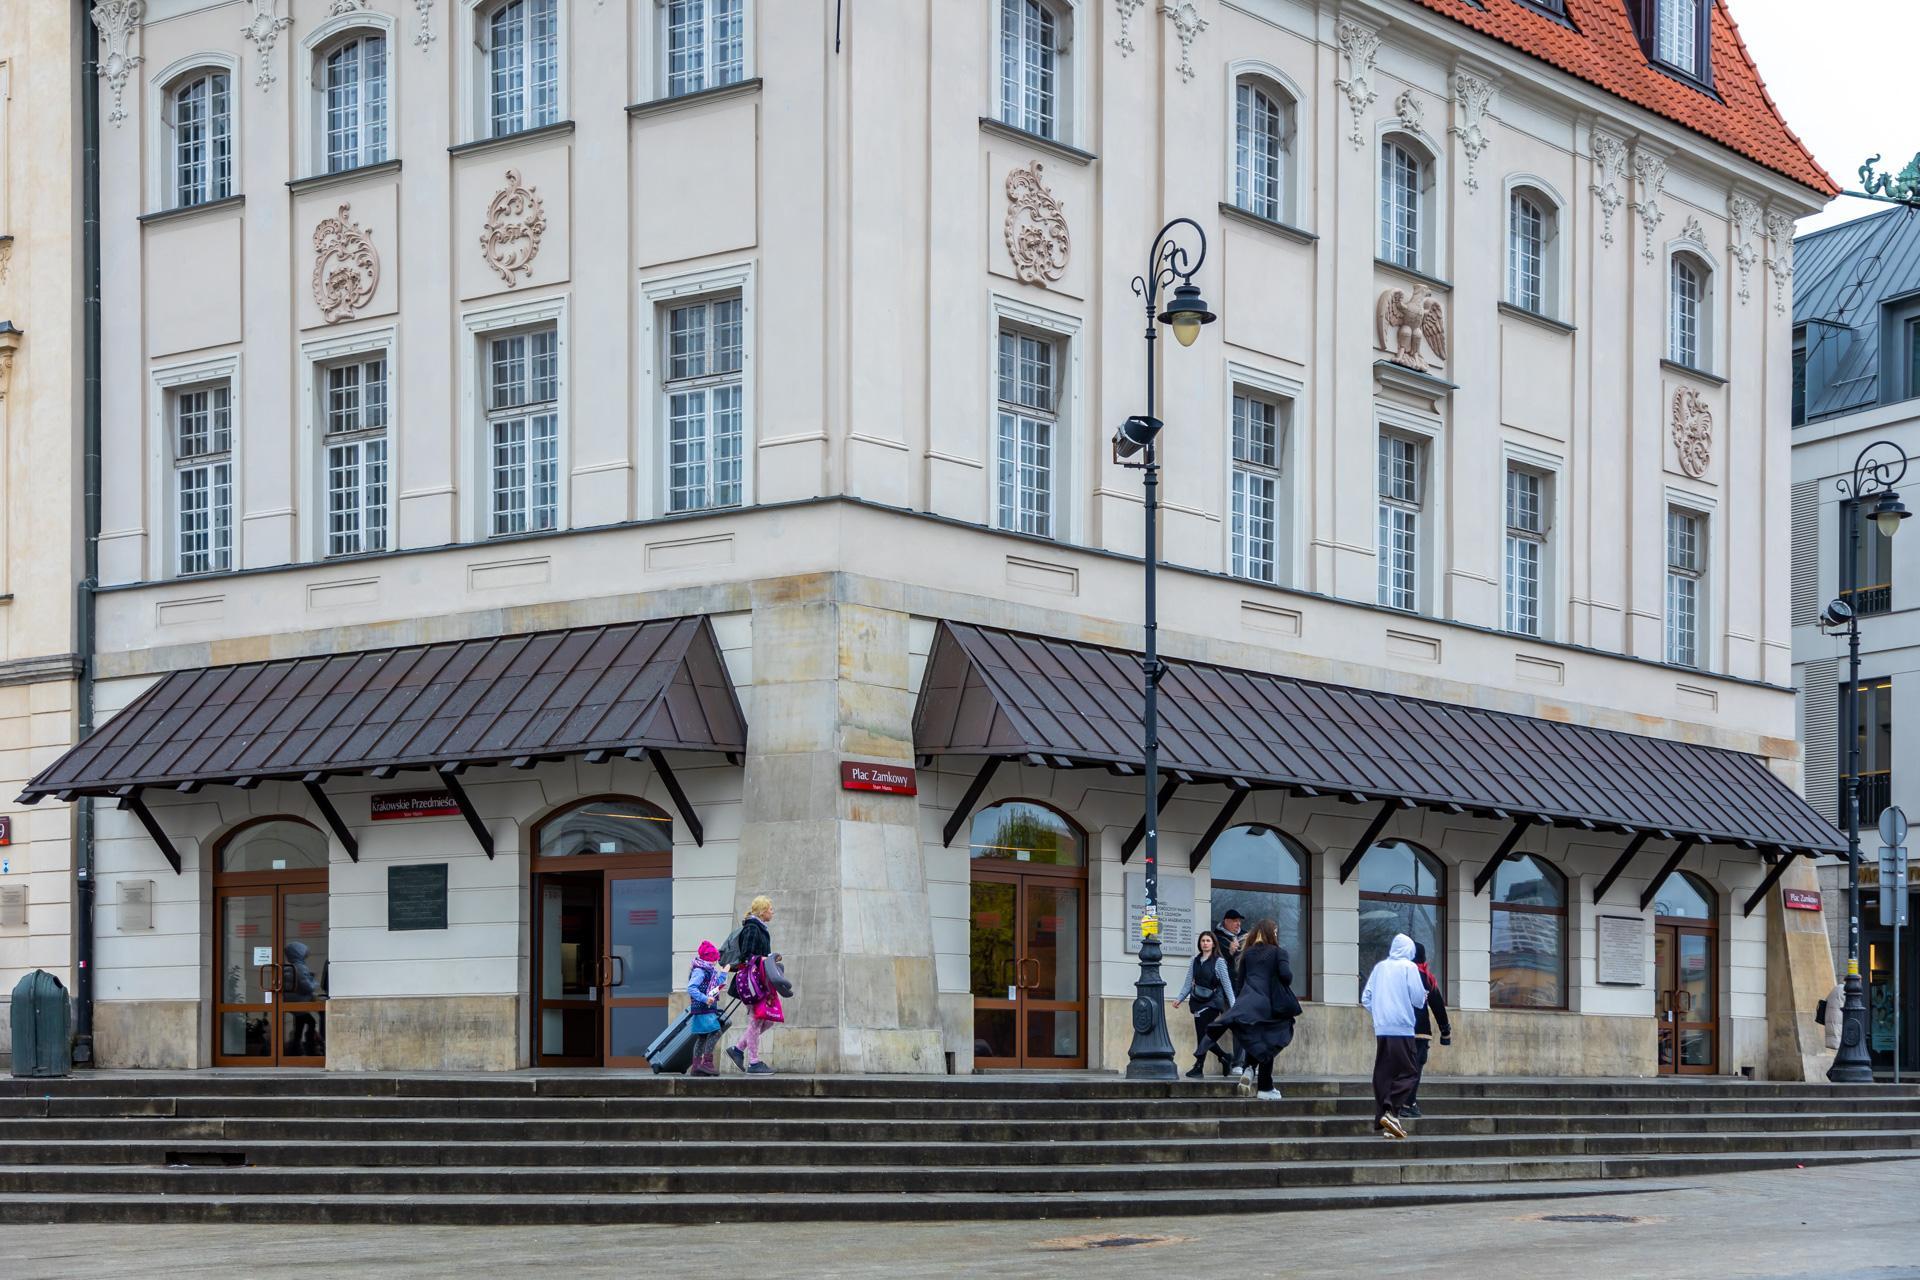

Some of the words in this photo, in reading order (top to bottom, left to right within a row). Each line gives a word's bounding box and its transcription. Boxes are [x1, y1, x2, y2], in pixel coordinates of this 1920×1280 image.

[852, 768, 869, 780] Plac
[871, 770, 908, 788] Zamkowy
[372, 799, 410, 812] Krakowskie
[411, 796, 458, 809] Przedmieści
